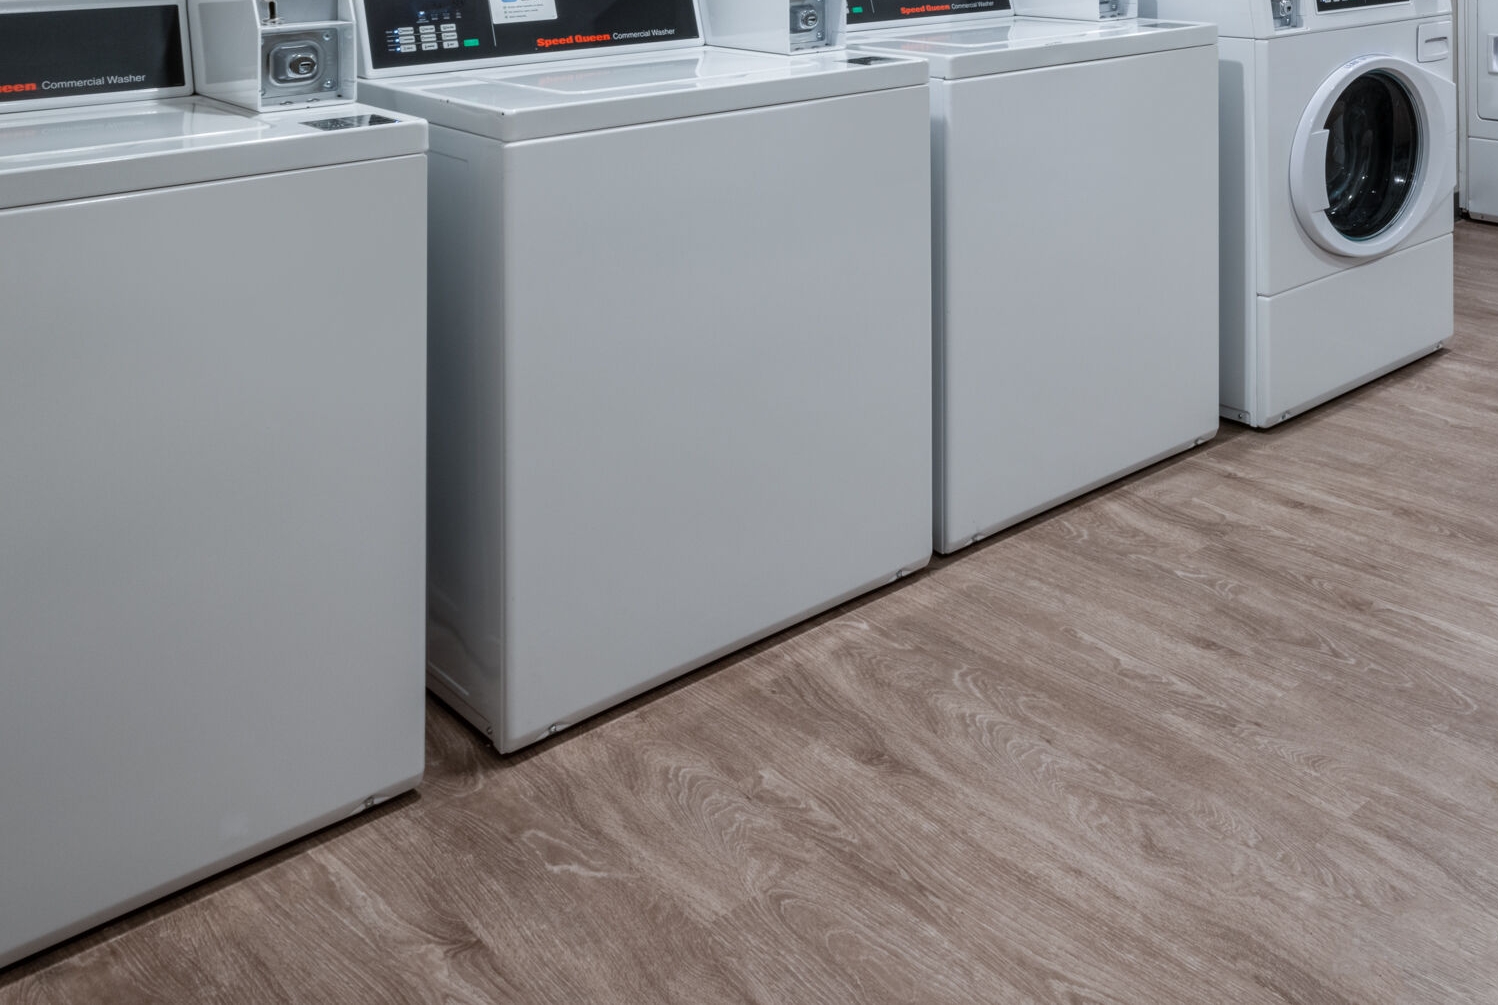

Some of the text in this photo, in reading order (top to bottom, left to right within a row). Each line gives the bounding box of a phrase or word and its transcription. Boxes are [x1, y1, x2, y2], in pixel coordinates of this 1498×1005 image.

[900, 5, 925, 15] Speed
[926, 3, 950, 12] Queen
[951, 1, 977, 10] Commercial
[537, 28, 675, 47] Speed Queen Commercial Washer
[0, 74, 146, 93] een Commercial Washer
